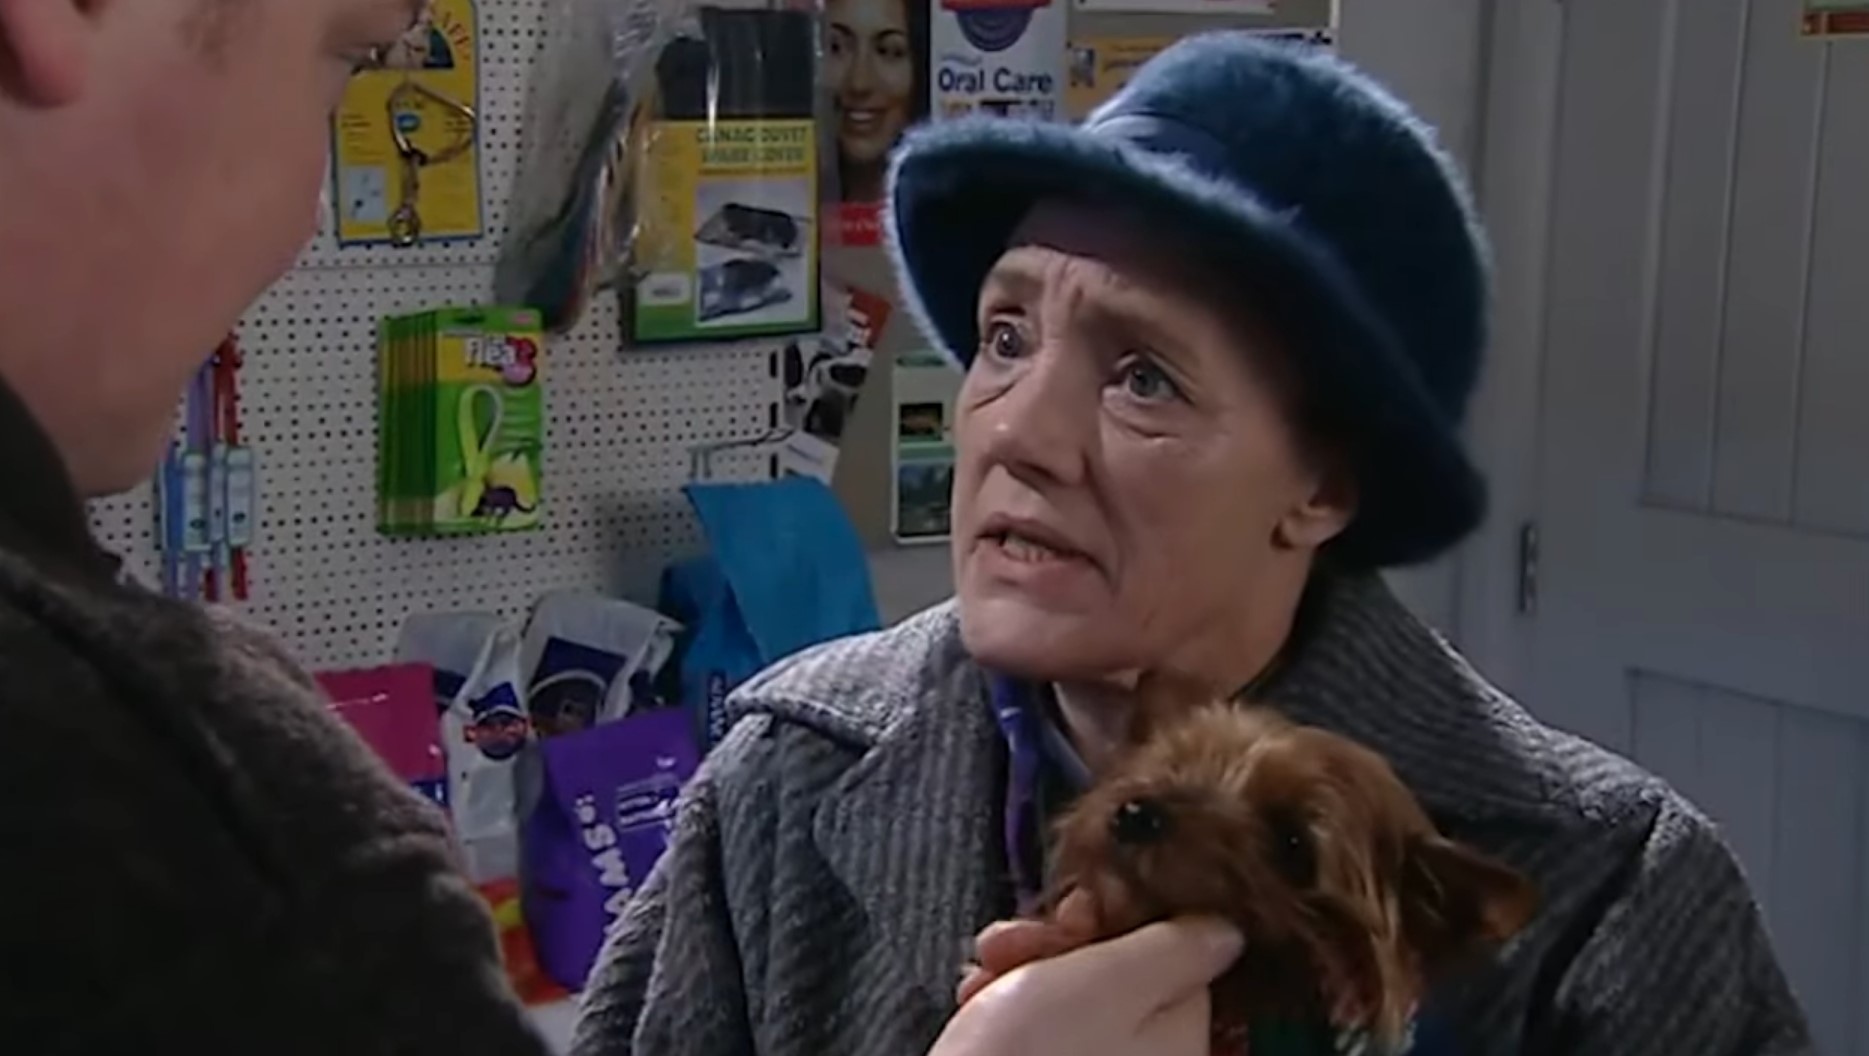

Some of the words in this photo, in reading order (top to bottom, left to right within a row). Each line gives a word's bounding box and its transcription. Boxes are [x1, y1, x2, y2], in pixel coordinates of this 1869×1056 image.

[938, 67, 985, 93] Oral
[993, 66, 1052, 94] Care
[465, 336, 517, 368] Flea
